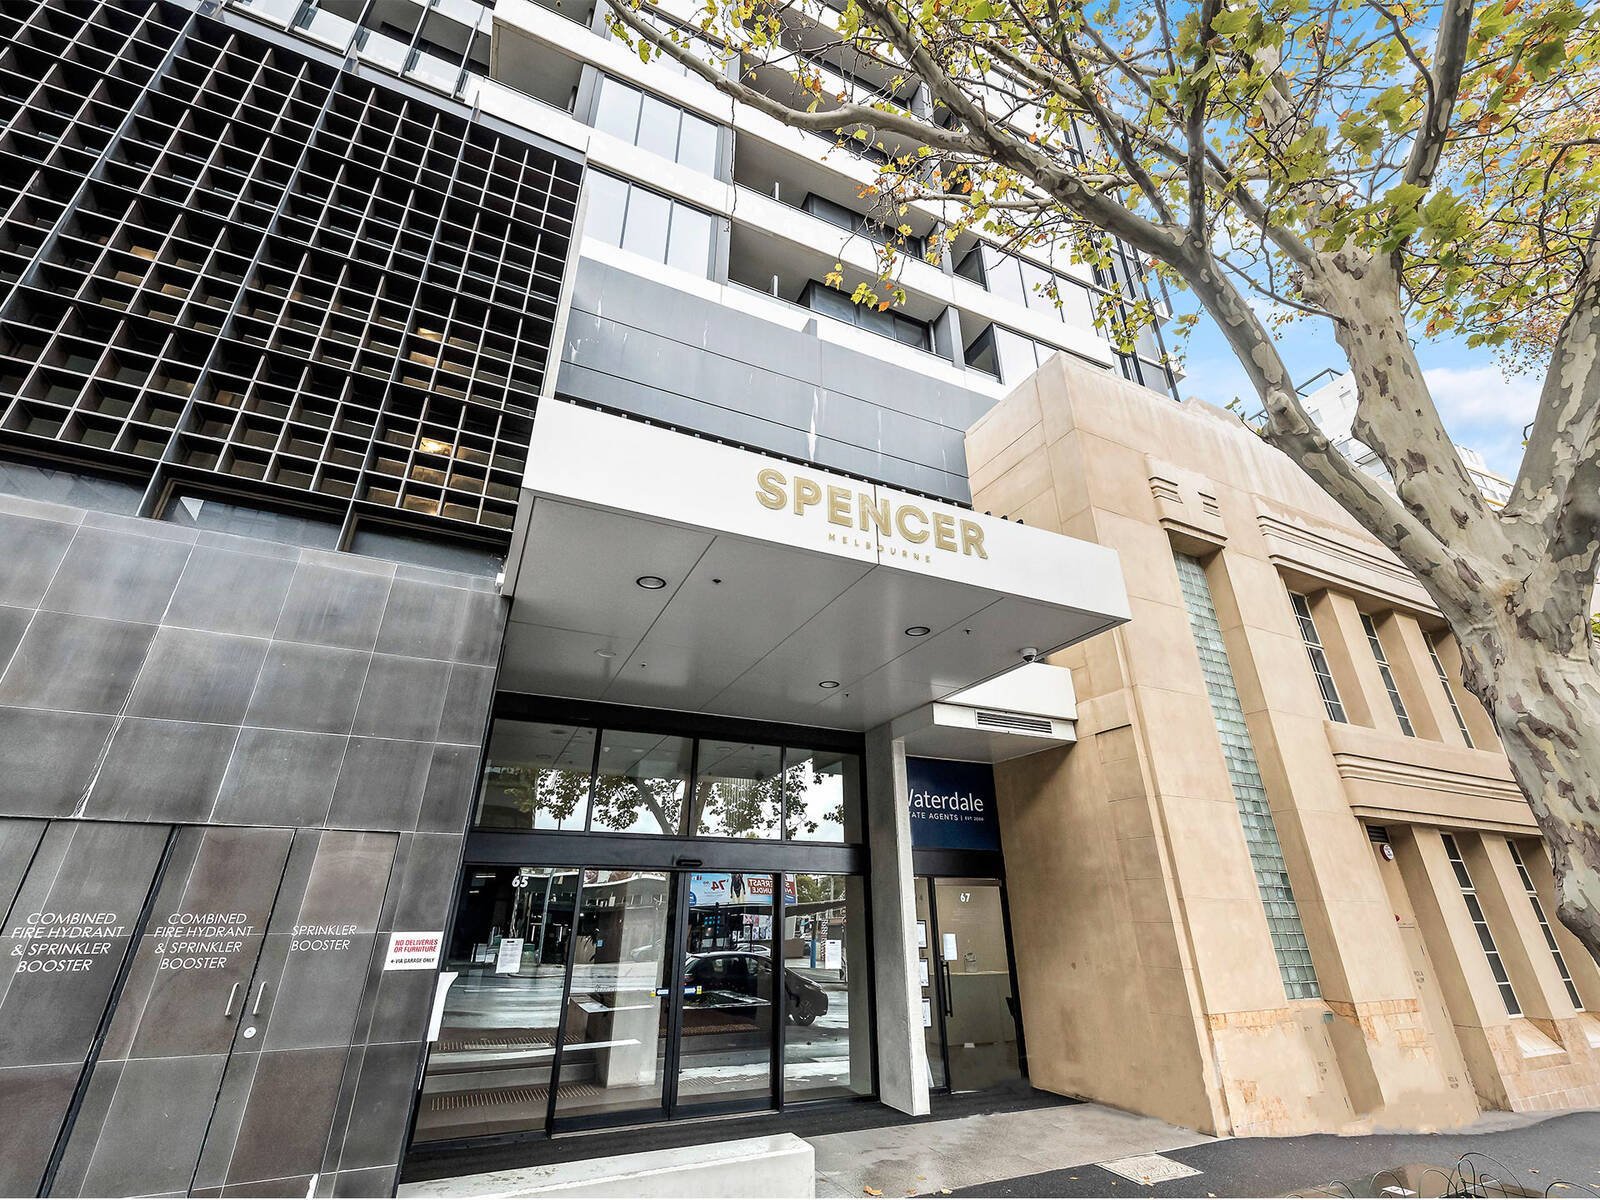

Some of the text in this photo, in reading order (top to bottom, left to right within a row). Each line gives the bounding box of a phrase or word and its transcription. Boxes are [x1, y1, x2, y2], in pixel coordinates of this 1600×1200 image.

[755, 468, 989, 560] SPENCER
[828, 533, 932, 563] MELBOURNE
[928, 813, 959, 821] AGENTS
[511, 875, 529, 888] 65
[960, 892, 971, 903] 67
[26, 912, 117, 925] COMBINED
[168, 913, 247, 925] COMBINED
[11, 926, 125, 939] FIRE HYDRANT
[153, 926, 254, 938] FIRE HYDRANT
[291, 924, 357, 937] SPRINKLER
[10, 942, 112, 956] & SPRINKLER
[154, 941, 243, 954] & SPRINKLER
[291, 939, 351, 951] BOOSTER
[17, 959, 93, 973] BOOSTER
[160, 957, 227, 970] BOOSTER
